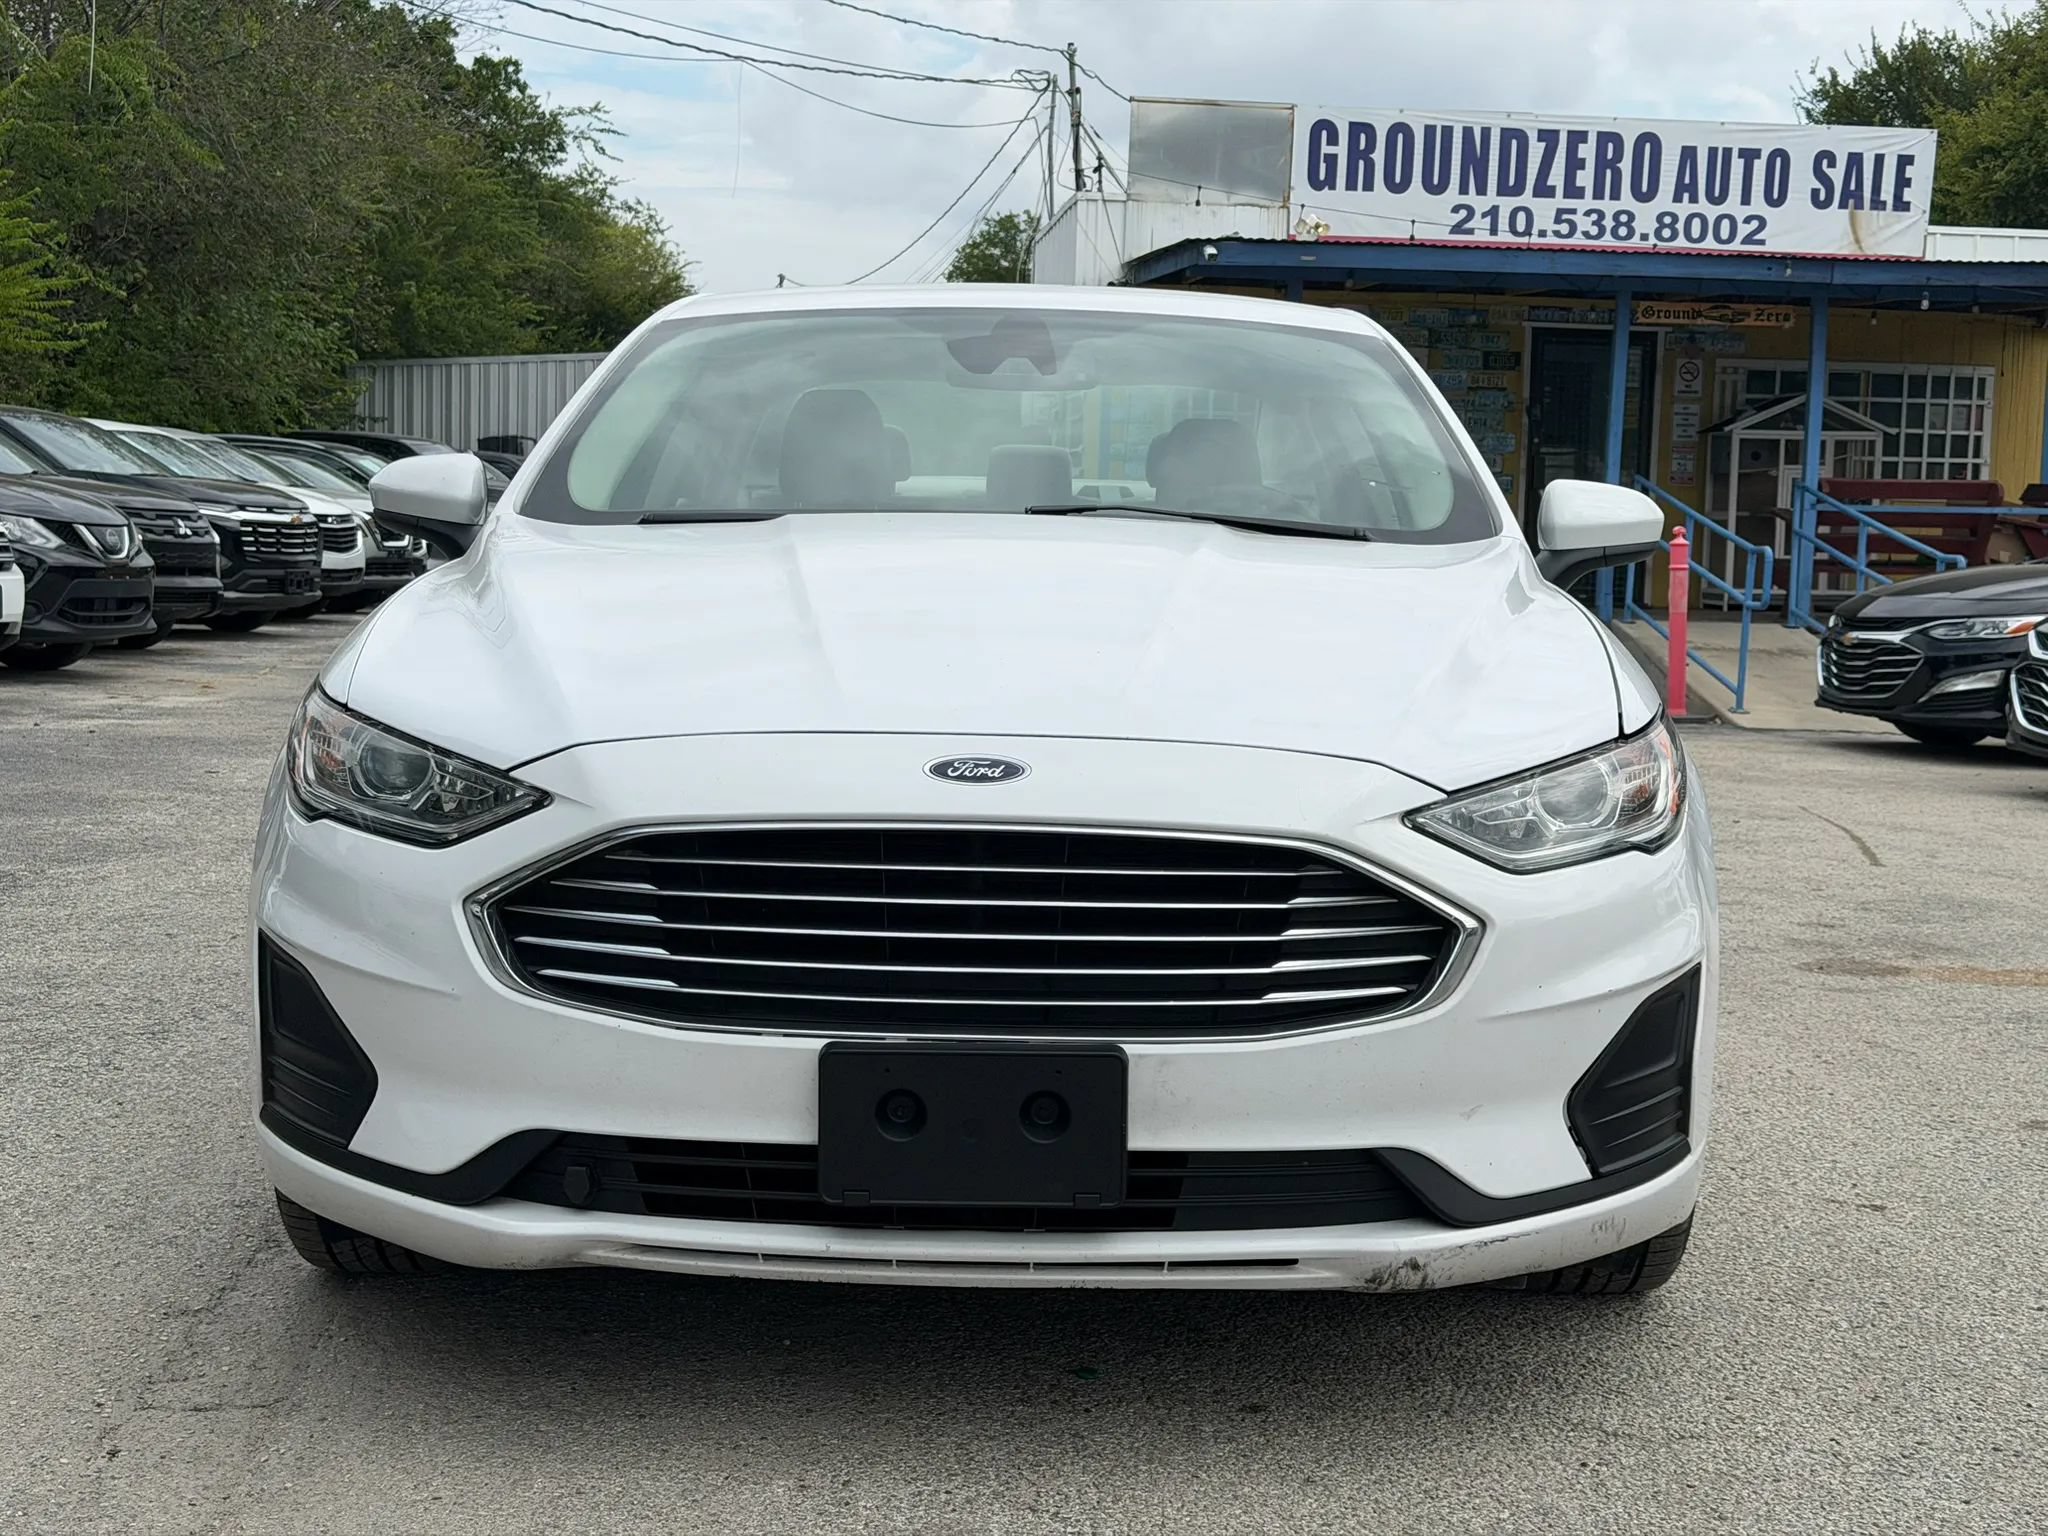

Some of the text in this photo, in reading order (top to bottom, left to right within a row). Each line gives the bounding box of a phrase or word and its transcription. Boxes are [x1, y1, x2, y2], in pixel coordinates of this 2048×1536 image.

[1306, 118, 1916, 213] GROUNDZERO AUTO SALE
[1448, 203, 1768, 246] 210.538.8002
[1641, 305, 1792, 322] Ground Zero
[947, 759, 1006, 778] Ford
